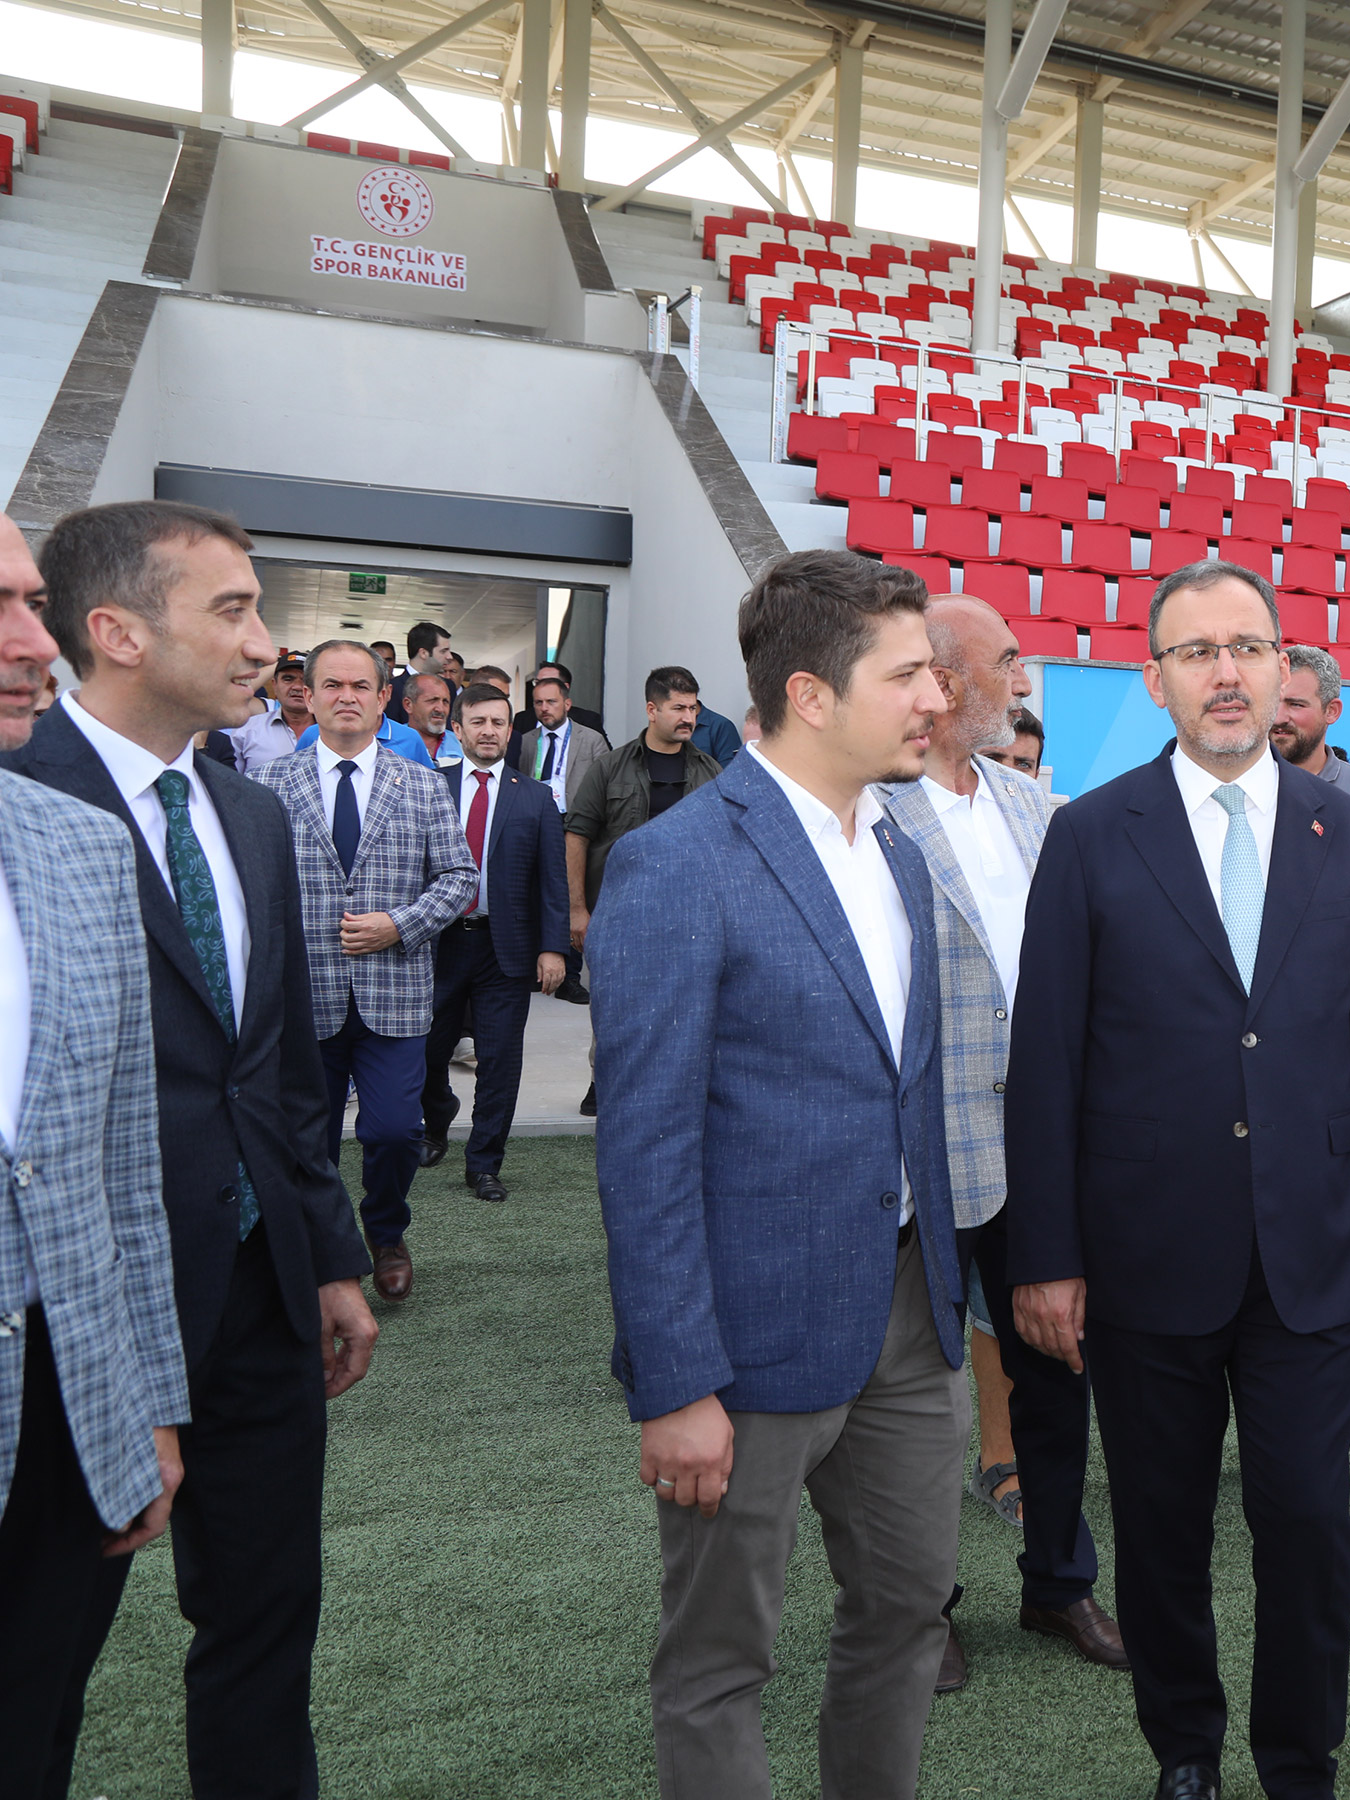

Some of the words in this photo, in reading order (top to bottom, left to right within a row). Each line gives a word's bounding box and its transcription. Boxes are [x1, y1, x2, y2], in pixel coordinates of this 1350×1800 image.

[313, 237, 347, 255] T.C.
[353, 243, 435, 266] GENÇLİK
[442, 254, 465, 270] VE
[313, 257, 362, 276] SPOR
[367, 263, 465, 290] BAKANLIĞI
